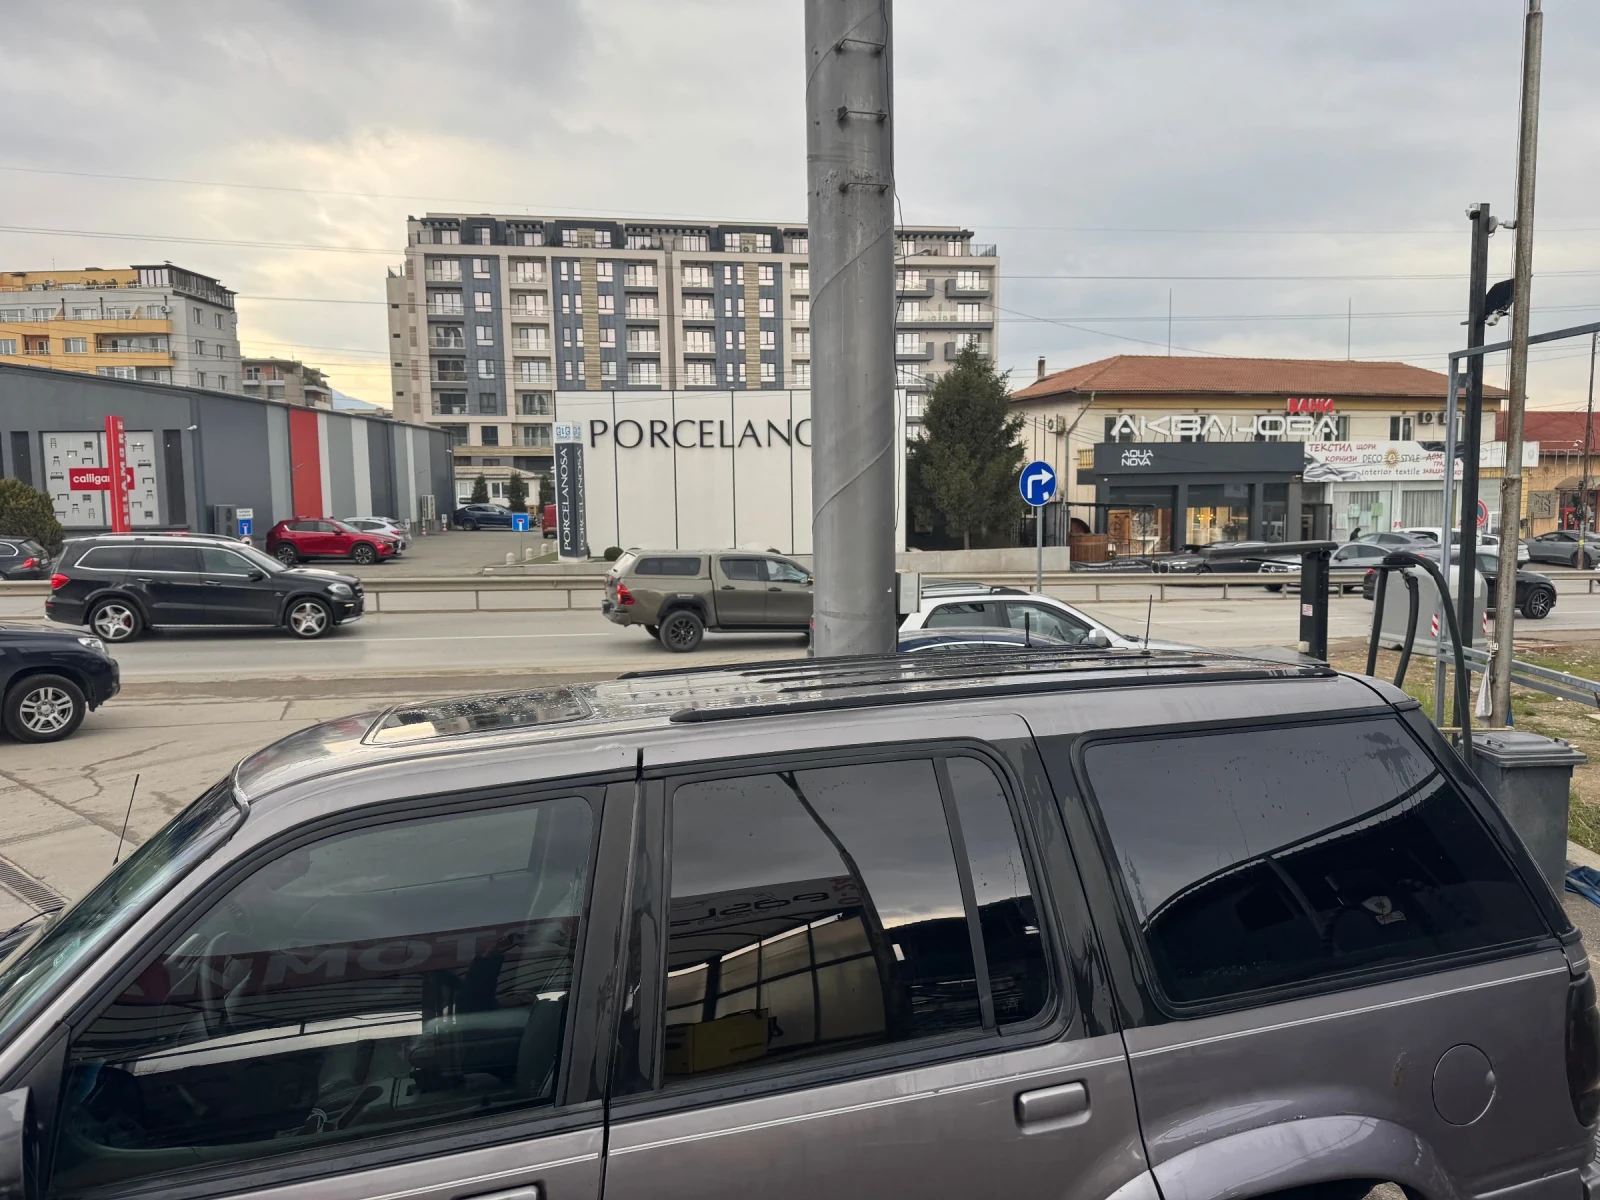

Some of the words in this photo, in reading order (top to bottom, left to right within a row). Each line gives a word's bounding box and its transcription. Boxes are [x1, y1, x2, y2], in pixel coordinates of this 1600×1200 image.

[1288, 398, 1334, 413] БАНИ
[1309, 443, 1353, 453] ТЕКСТИЛ
[1121, 449, 1154, 458] AQUA
[1121, 458, 1152, 467] NOVA
[1362, 454, 1383, 464] DECO
[1400, 454, 1421, 463] STYLE
[1395, 467, 1421, 476] textile
[560, 447, 572, 550] PORCELANOSA
